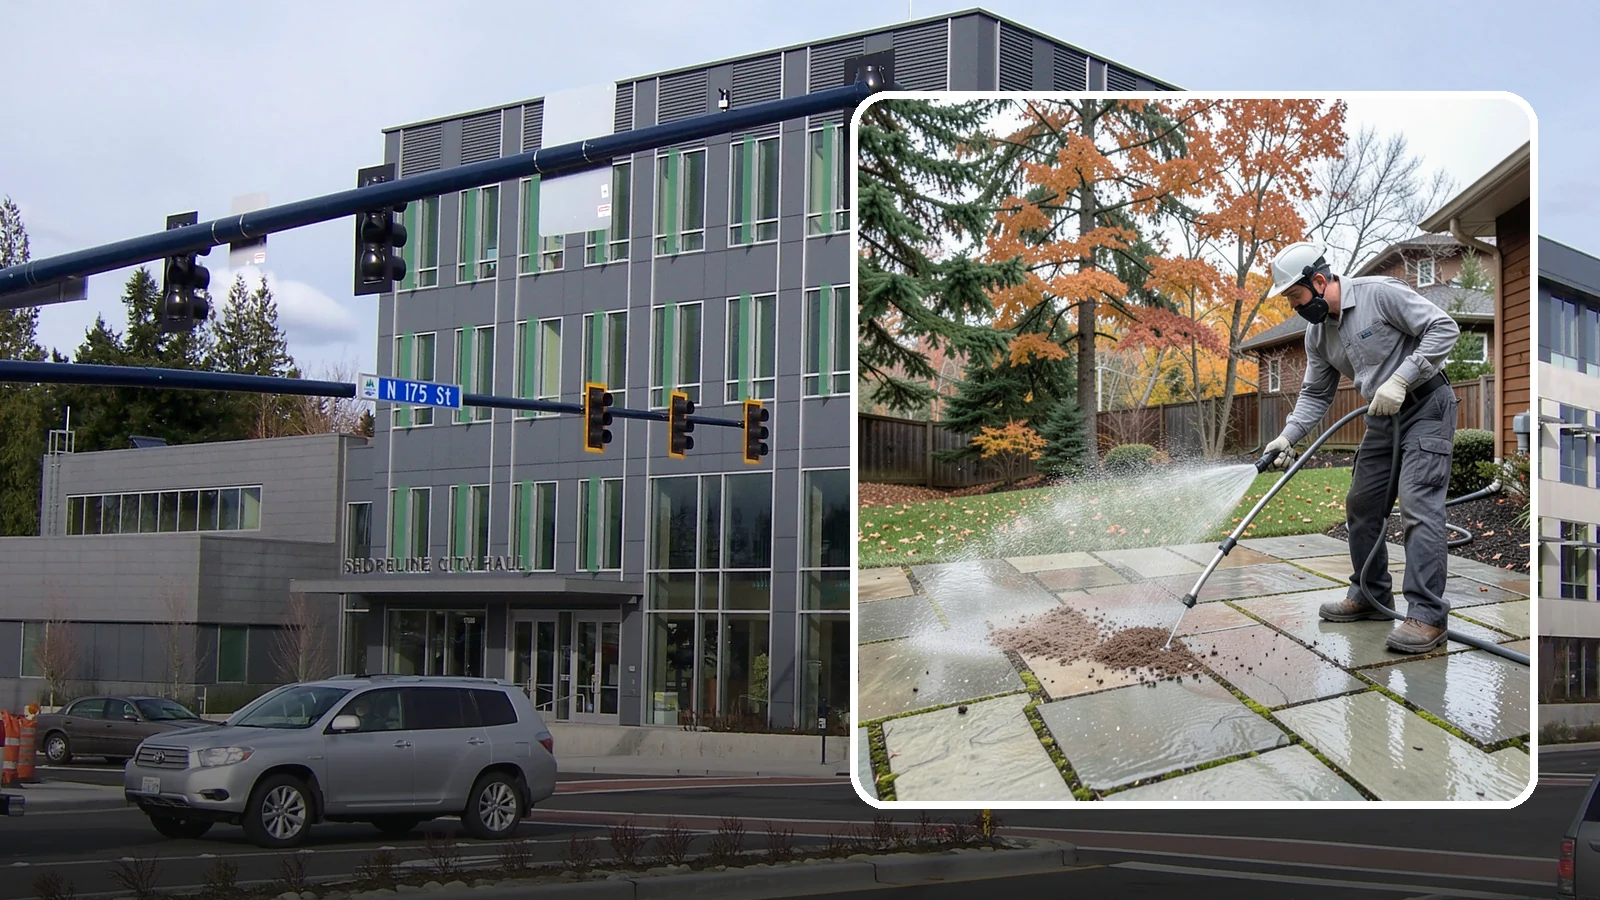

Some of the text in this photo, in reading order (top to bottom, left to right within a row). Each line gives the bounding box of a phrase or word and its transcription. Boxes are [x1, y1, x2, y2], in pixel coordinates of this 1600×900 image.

[387, 380, 451, 406] N 175 St
[343, 556, 525, 573] SHORELINE CITY HALL
